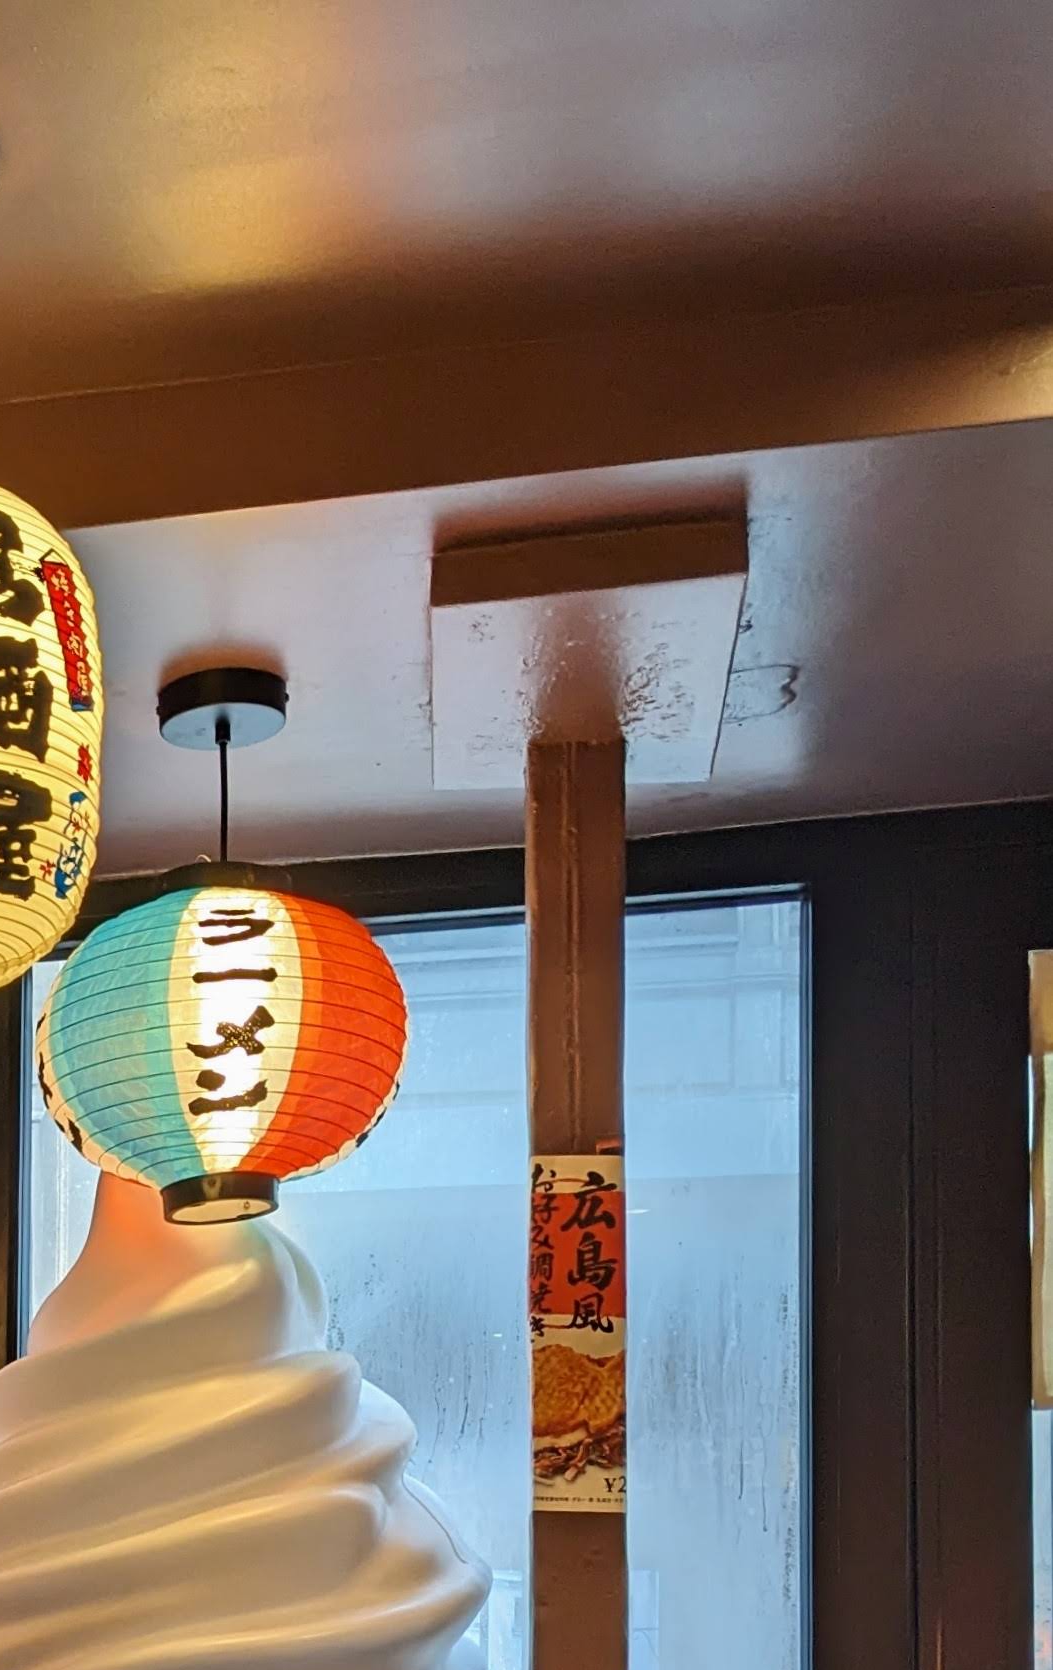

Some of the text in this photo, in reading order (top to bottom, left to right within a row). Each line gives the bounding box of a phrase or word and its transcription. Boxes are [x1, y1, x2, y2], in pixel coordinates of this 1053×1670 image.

[186, 908, 277, 1116] ラーメン
[560, 1171, 619, 1333] 広島風
